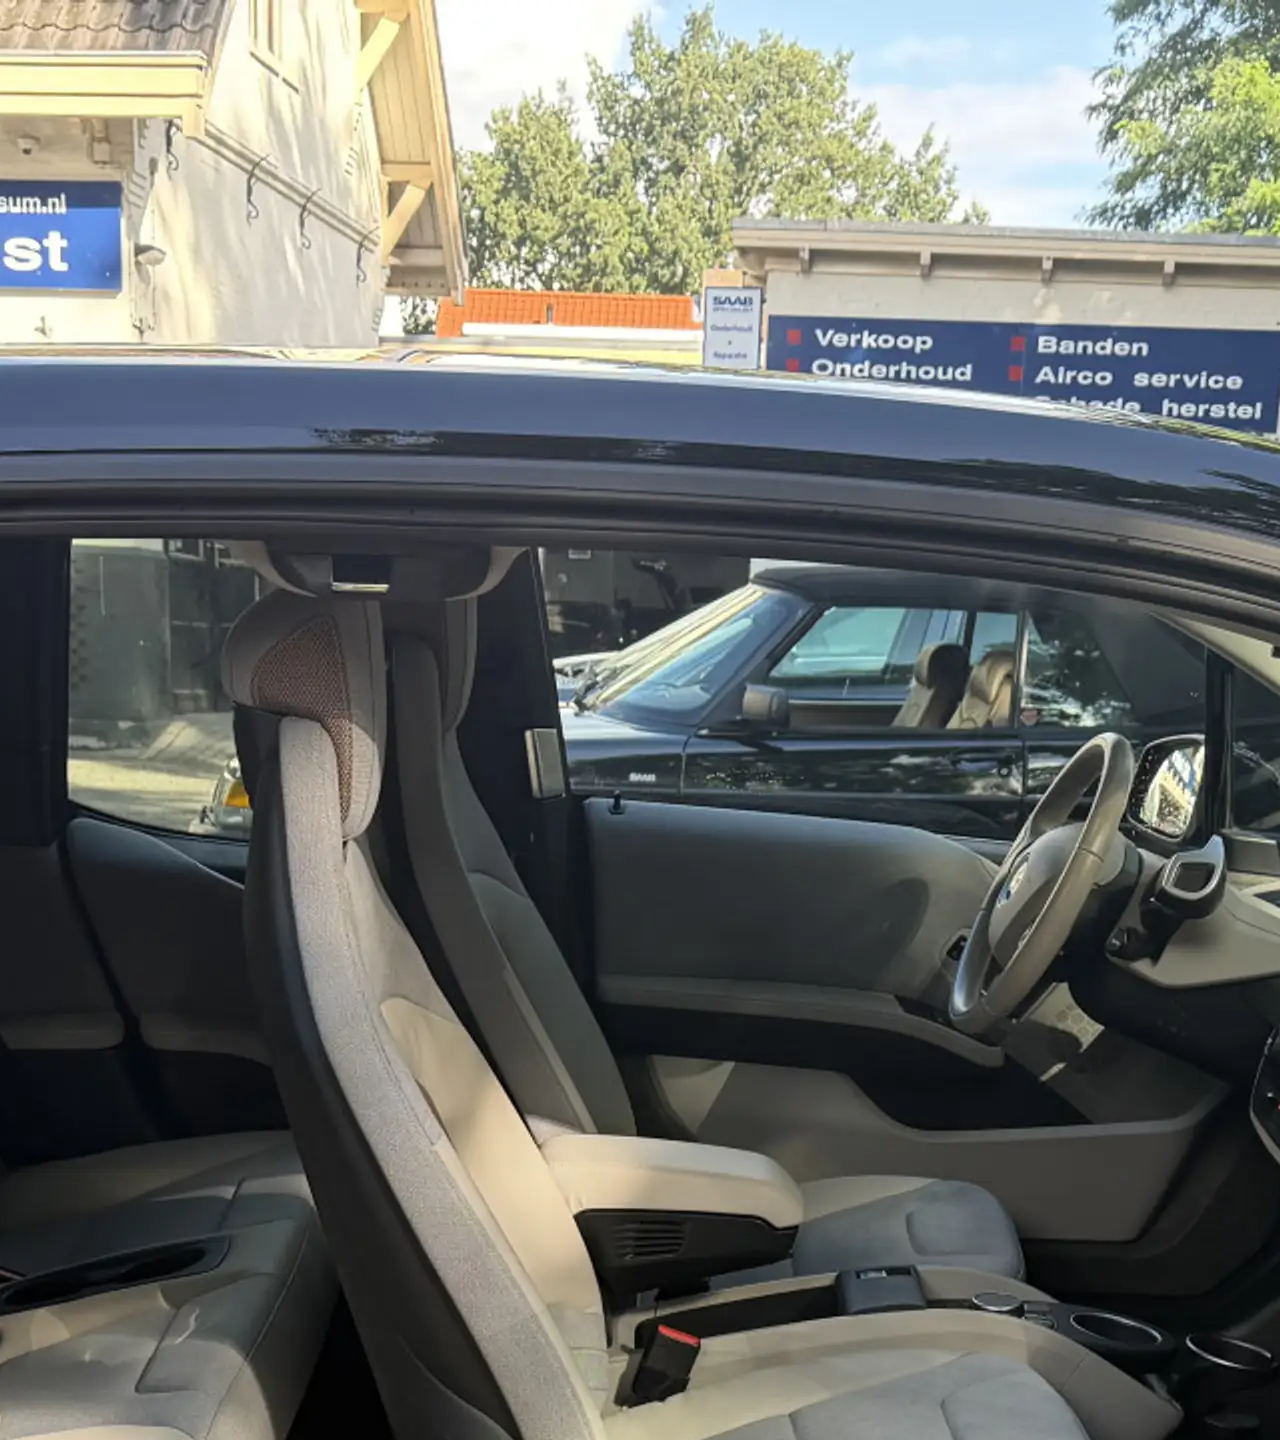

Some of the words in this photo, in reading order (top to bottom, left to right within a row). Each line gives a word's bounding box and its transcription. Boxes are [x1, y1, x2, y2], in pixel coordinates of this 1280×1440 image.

[814, 328, 933, 353] Verkoop
[1037, 335, 1150, 358] Banden
[811, 358, 972, 381] Onderhoud
[1034, 365, 1114, 387] Airco
[1133, 370, 1244, 391] service
[1036, 395, 1141, 413] hade
[1162, 398, 1263, 421] herstel
